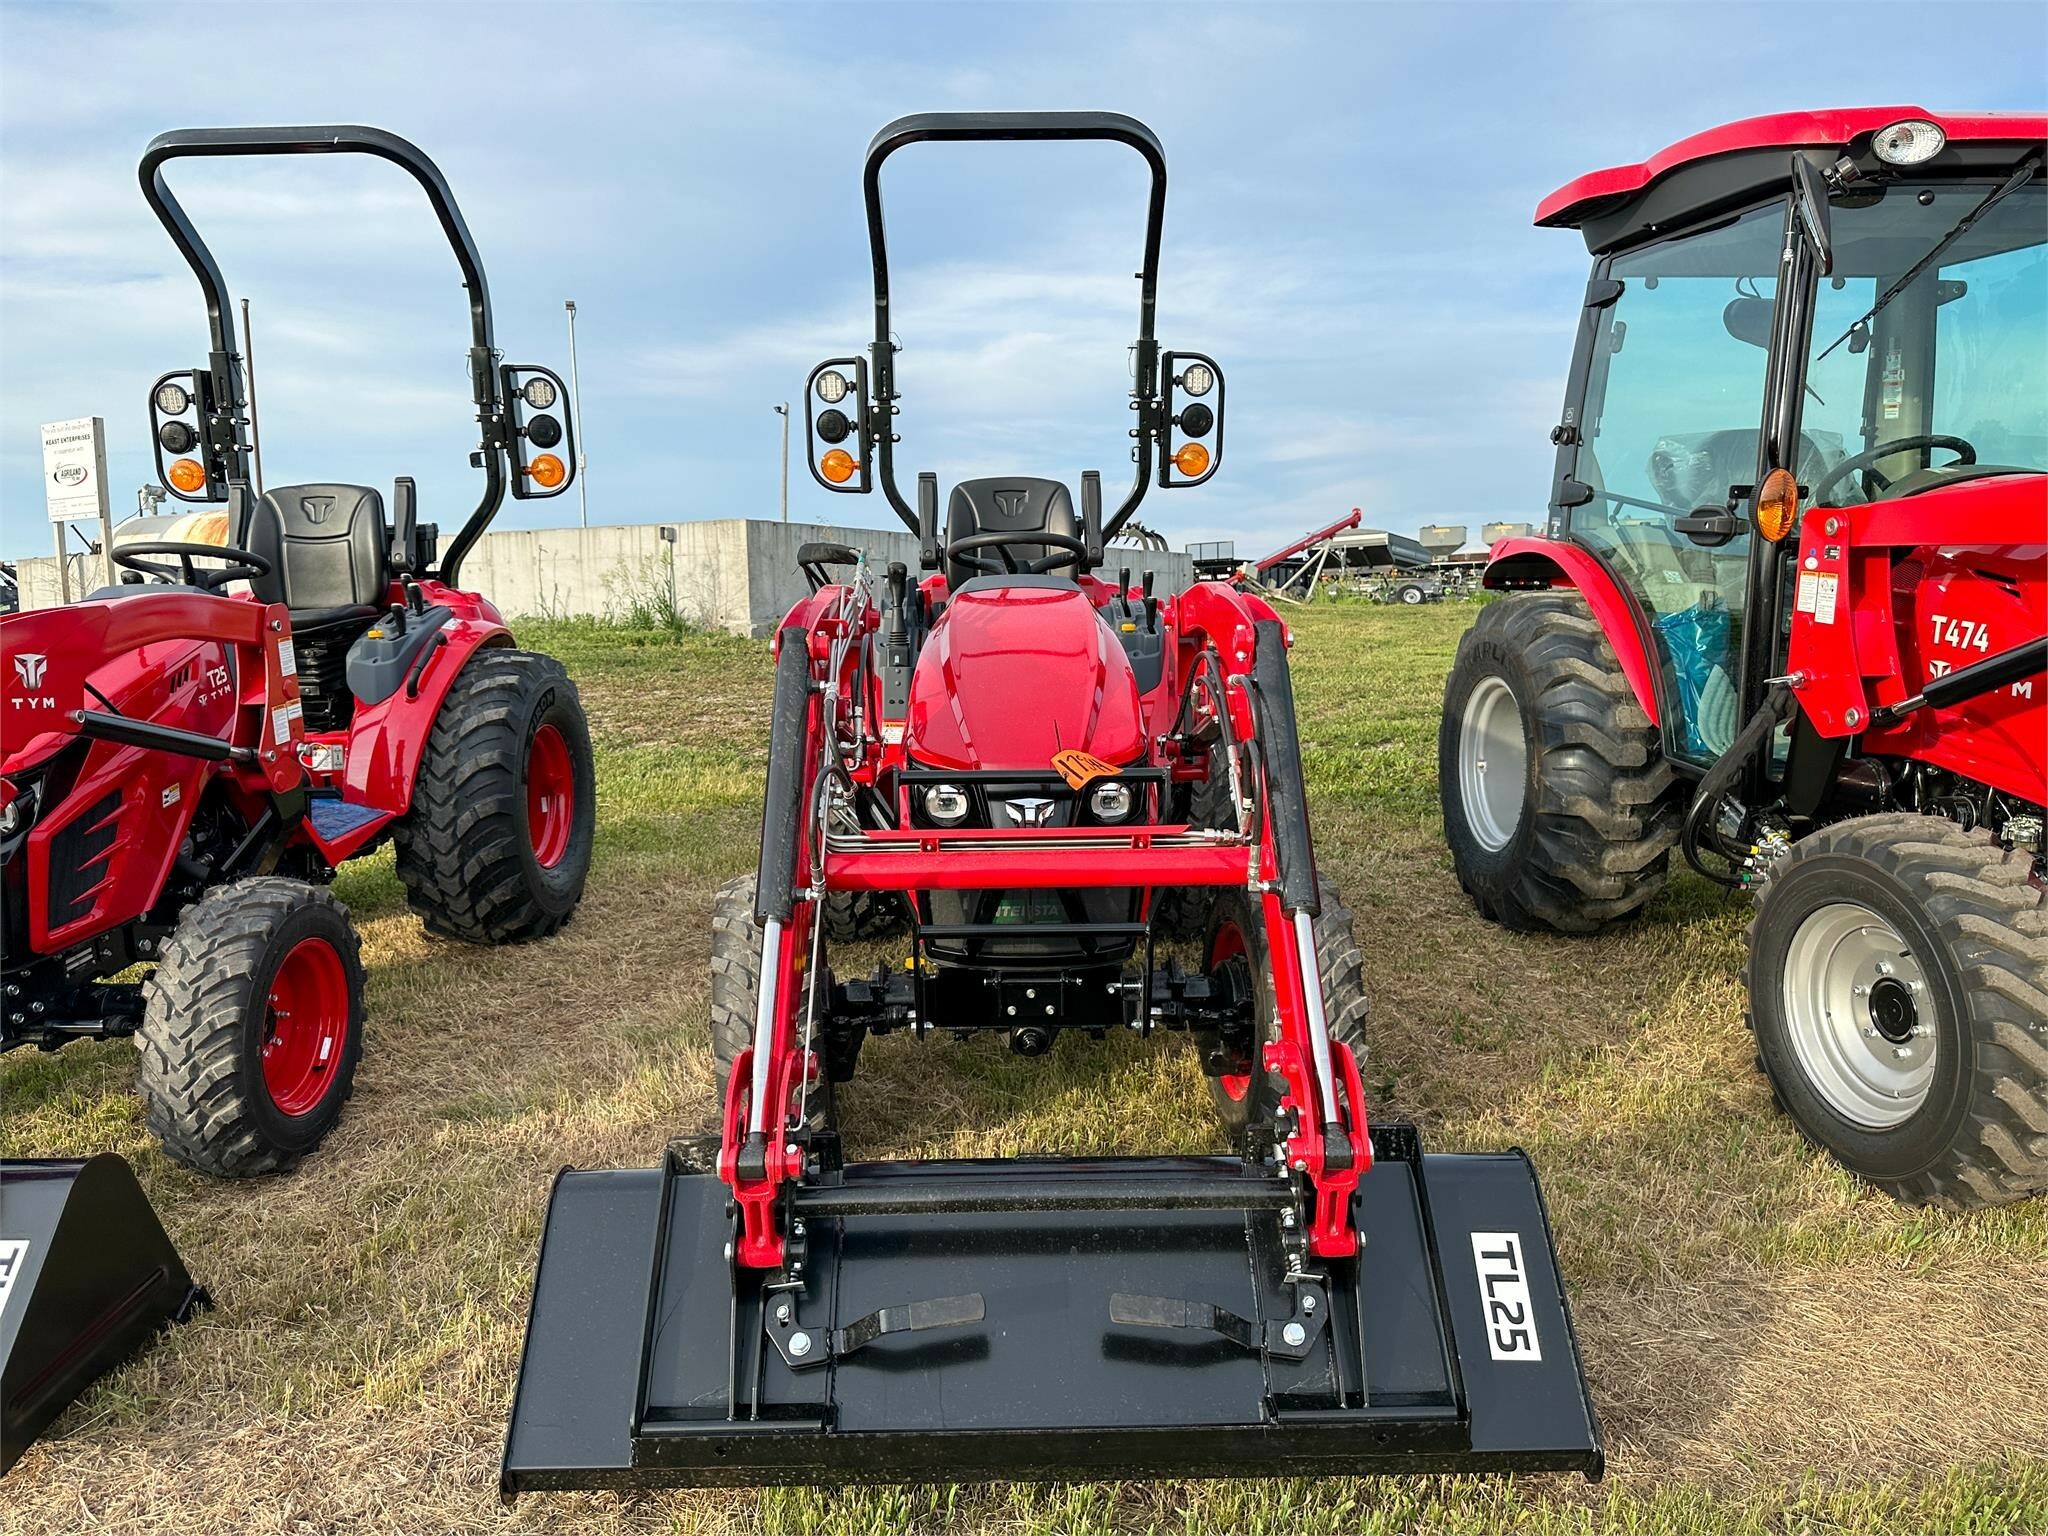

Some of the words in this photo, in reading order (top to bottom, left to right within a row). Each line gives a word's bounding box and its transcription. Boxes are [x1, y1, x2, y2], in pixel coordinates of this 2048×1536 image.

[1931, 614, 1989, 653] T474
[206, 665, 228, 689] T25
[11, 697, 55, 710] TYM
[210, 684, 231, 700] TYM
[1480, 1240, 1531, 1352] TL25
